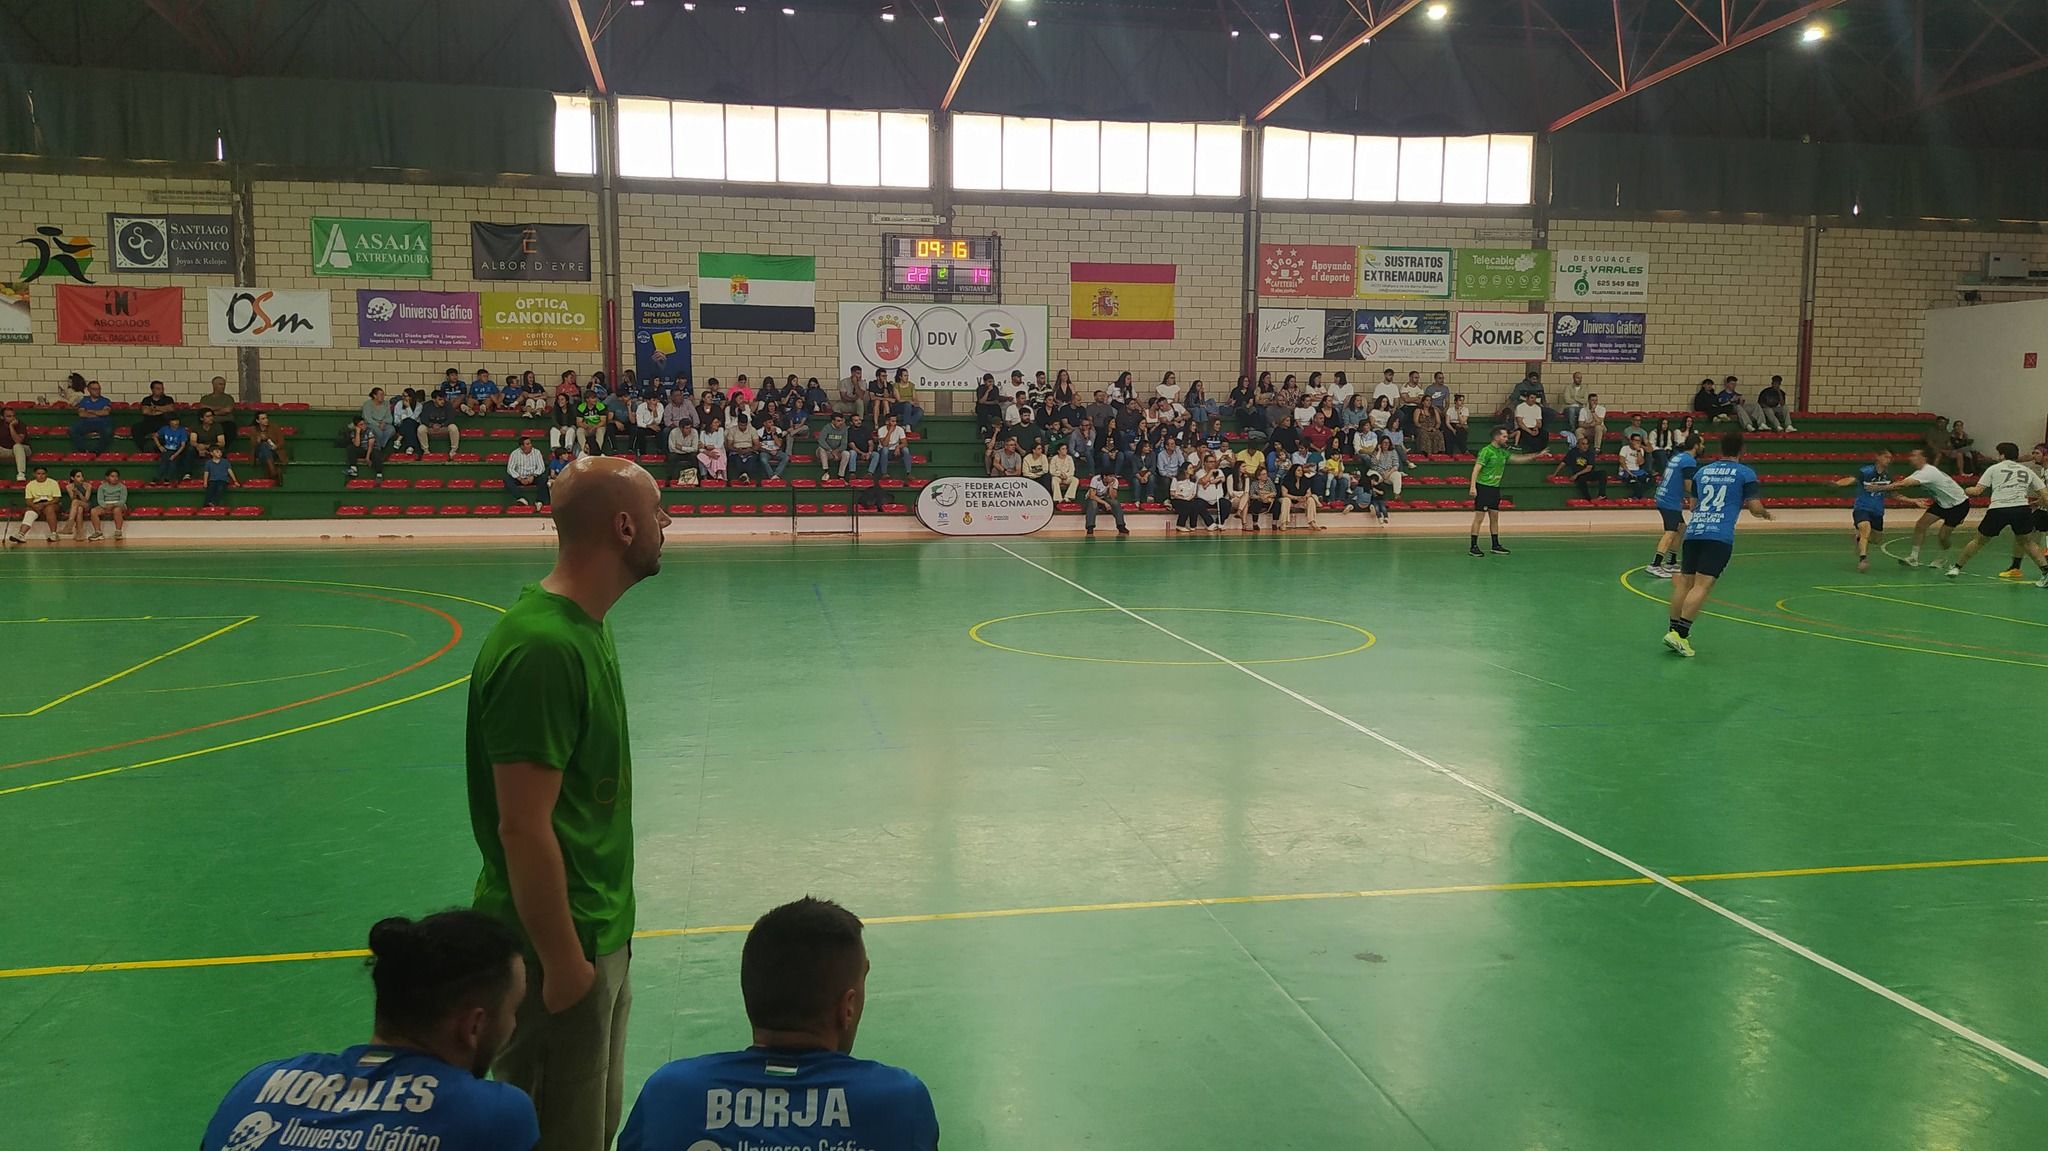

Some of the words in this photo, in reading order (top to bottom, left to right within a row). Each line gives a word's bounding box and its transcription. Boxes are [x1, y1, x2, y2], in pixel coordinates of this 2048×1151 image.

[170, 223, 229, 235] SANTIAGO
[170, 237, 230, 251] CANÓNICO
[354, 233, 427, 251] ASAJA
[918, 241, 967, 258] 09:16
[175, 256, 194, 266] Joyas
[195, 257, 202, 265] &
[203, 257, 227, 266] Relojes
[355, 252, 430, 264] EXTREMADURA
[1384, 255, 1444, 268] SUSTRATOS
[1472, 255, 1515, 265] Telecable
[1573, 255, 1632, 263] DESGUACE
[481, 261, 527, 271] ALBOR
[1311, 260, 1352, 272] Apoyando
[1560, 265, 1582, 273] LOS
[1590, 265, 1644, 274] VARALES
[907, 267, 929, 282] 22
[939, 267, 946, 278] 2
[973, 268, 989, 284] 14
[1311, 271, 1318, 281] el
[1320, 271, 1350, 283] deporte
[1364, 270, 1444, 283] EXTREMADURA
[515, 297, 569, 310] ÓPTICA
[399, 303, 439, 319] Universo
[440, 304, 473, 320] Gráfico
[495, 311, 586, 325] CANONICO
[94, 319, 151, 328] ABOGADOS
[1374, 313, 1418, 329] MUÑOZ
[1582, 319, 1615, 334] Universo
[1616, 320, 1643, 335] Gráfico
[927, 331, 958, 346] DDV
[1289, 326, 1318, 345] José
[522, 339, 558, 347] auditivo
[1260, 342, 1317, 354] Matamoros
[1380, 338, 1397, 346] ALFA
[1399, 338, 1446, 347] VILLAFRANCA
[920, 376, 969, 388] Deportes
[2000, 469, 2029, 484] 79
[965, 481, 1028, 490] FEDERACIÓN
[965, 490, 1023, 499] EXTREMEÑA
[1700, 484, 1727, 511] 24
[966, 500, 979, 508] DE
[981, 499, 1049, 508] BALONMANO
[254, 1069, 440, 1113] MORALES
[706, 1087, 850, 1130] BORJA
[279, 1116, 363, 1150] Universo
[364, 1122, 441, 1151] Gráfico
